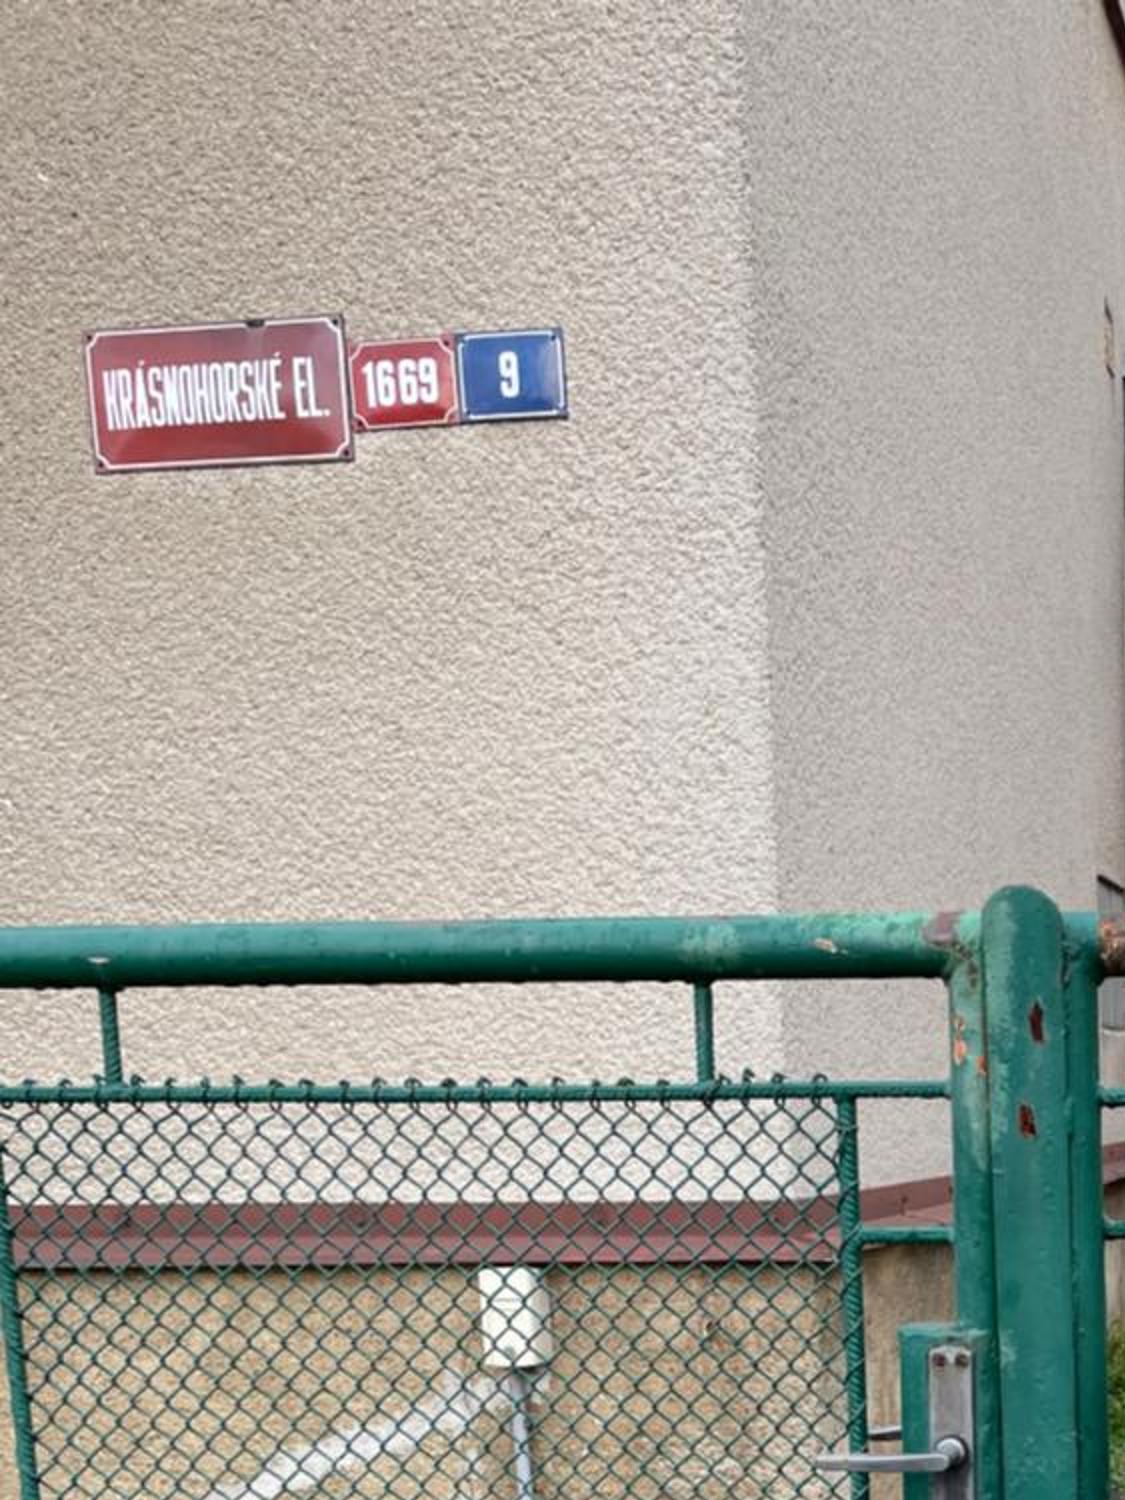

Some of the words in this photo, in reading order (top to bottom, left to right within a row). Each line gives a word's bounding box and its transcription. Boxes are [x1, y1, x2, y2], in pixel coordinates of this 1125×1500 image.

[103, 352, 286, 431] KRÁSNOHORSKÉ
[292, 356, 331, 418] EL.
[361, 357, 440, 408] 1669
[498, 351, 520, 398] 9
